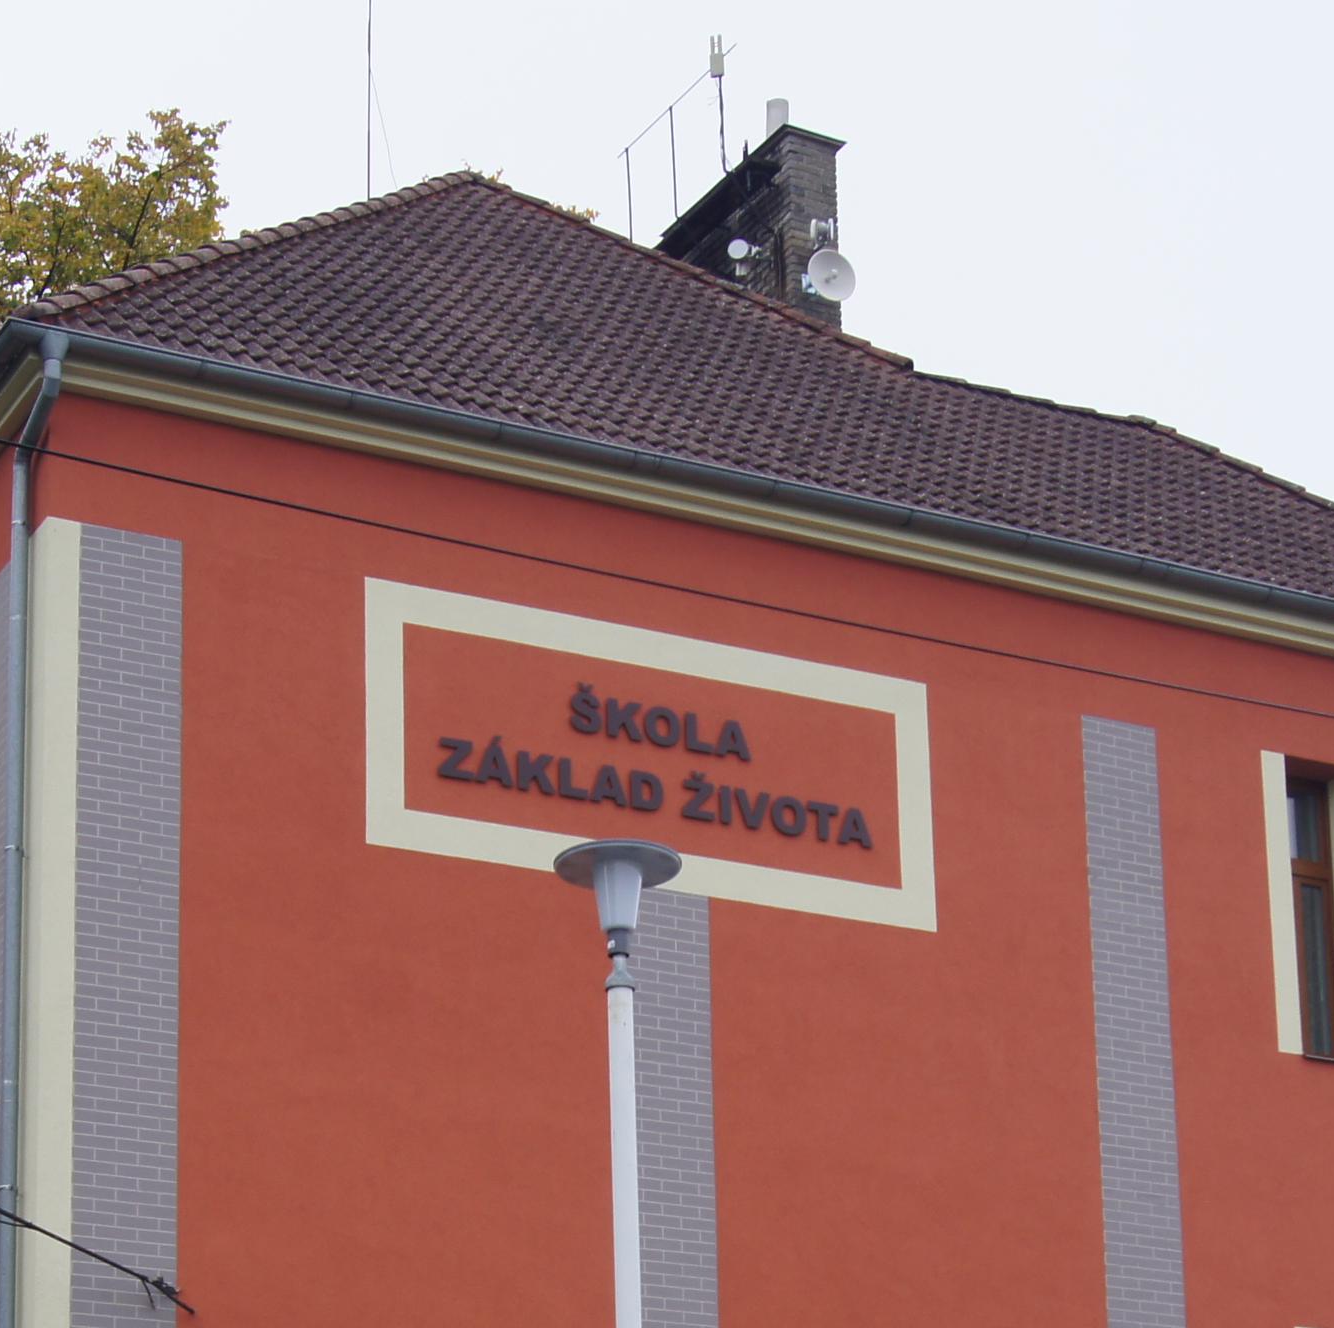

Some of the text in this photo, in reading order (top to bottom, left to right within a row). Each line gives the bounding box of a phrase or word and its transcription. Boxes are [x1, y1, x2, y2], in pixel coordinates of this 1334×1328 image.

[571, 682, 752, 762] ŠKOLA
[437, 735, 873, 849] ZÁKLAD ŽIVOTA
